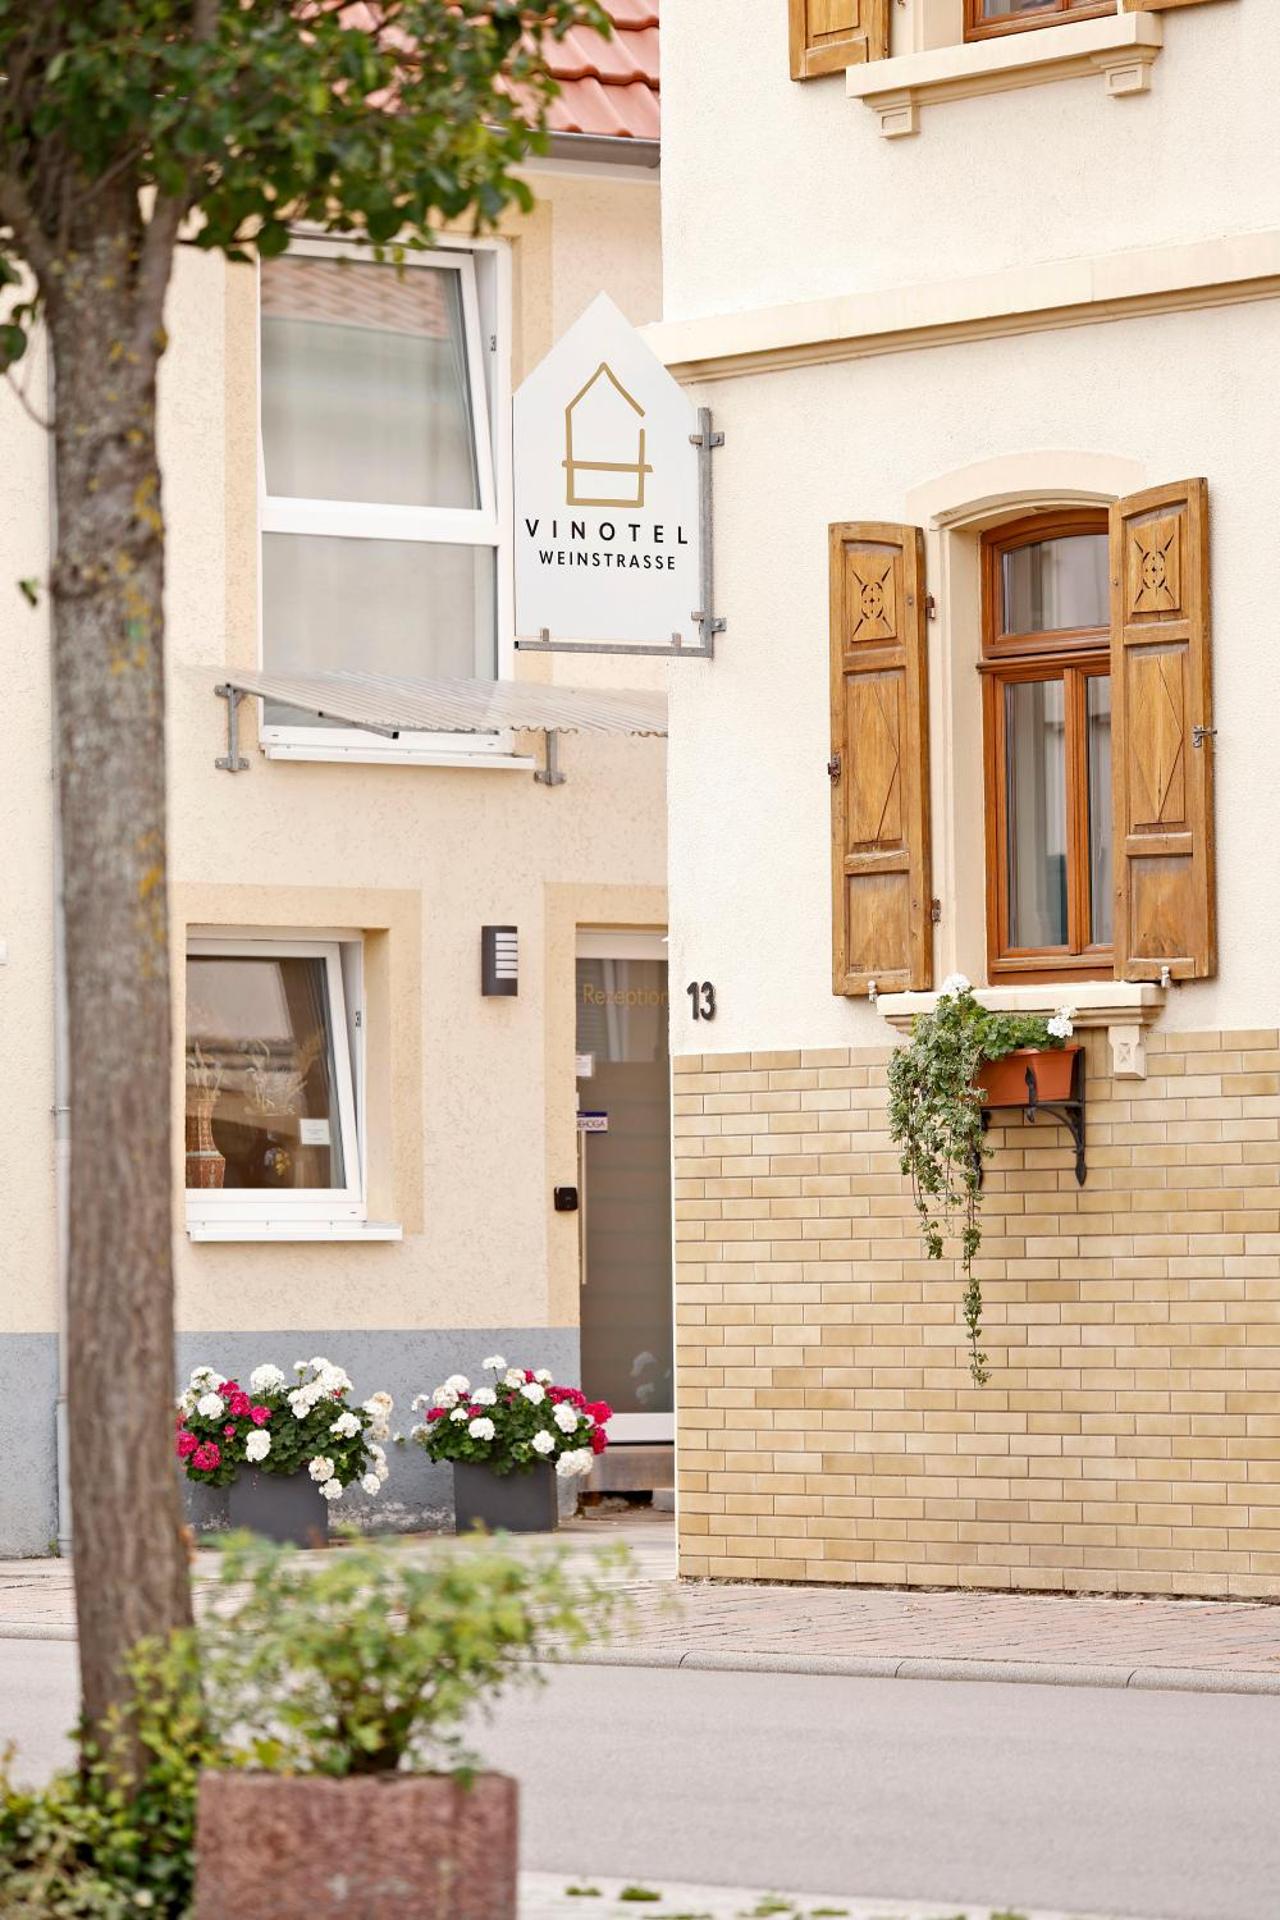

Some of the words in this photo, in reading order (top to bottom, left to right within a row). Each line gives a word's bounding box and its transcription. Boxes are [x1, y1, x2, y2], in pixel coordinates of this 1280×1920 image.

[525, 519, 688, 544] VINOTEL
[539, 550, 676, 570] WEINSTRASSE
[686, 981, 717, 1020] 13
